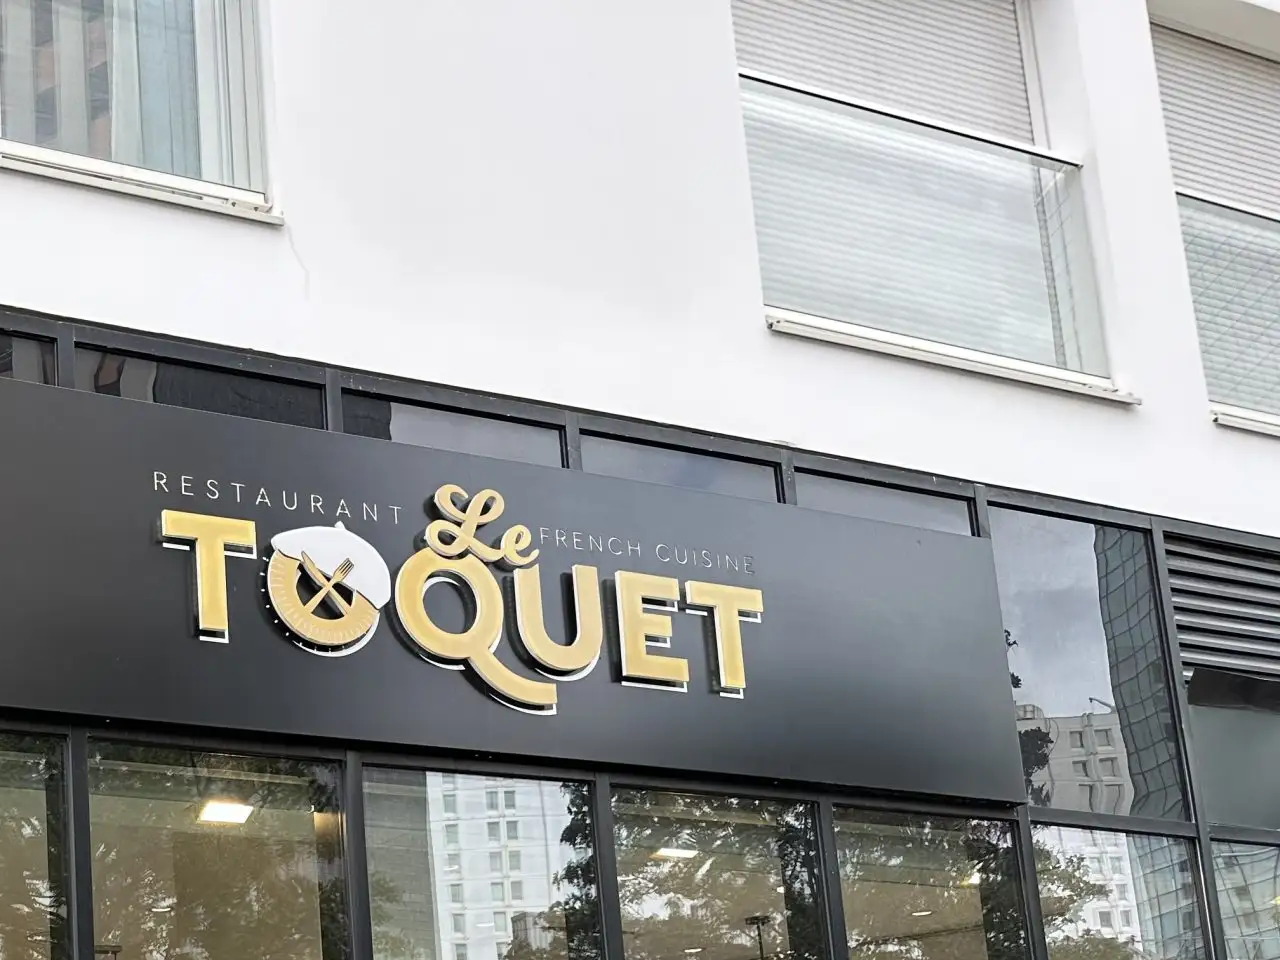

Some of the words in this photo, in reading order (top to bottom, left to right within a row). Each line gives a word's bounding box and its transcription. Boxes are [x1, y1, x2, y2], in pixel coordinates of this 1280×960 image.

[154, 471, 404, 525] RESTAURANT
[424, 483, 540, 567] Le
[539, 527, 642, 558] FRENCH
[656, 543, 755, 575] CUISINE
[161, 508, 763, 714] TOQUET
